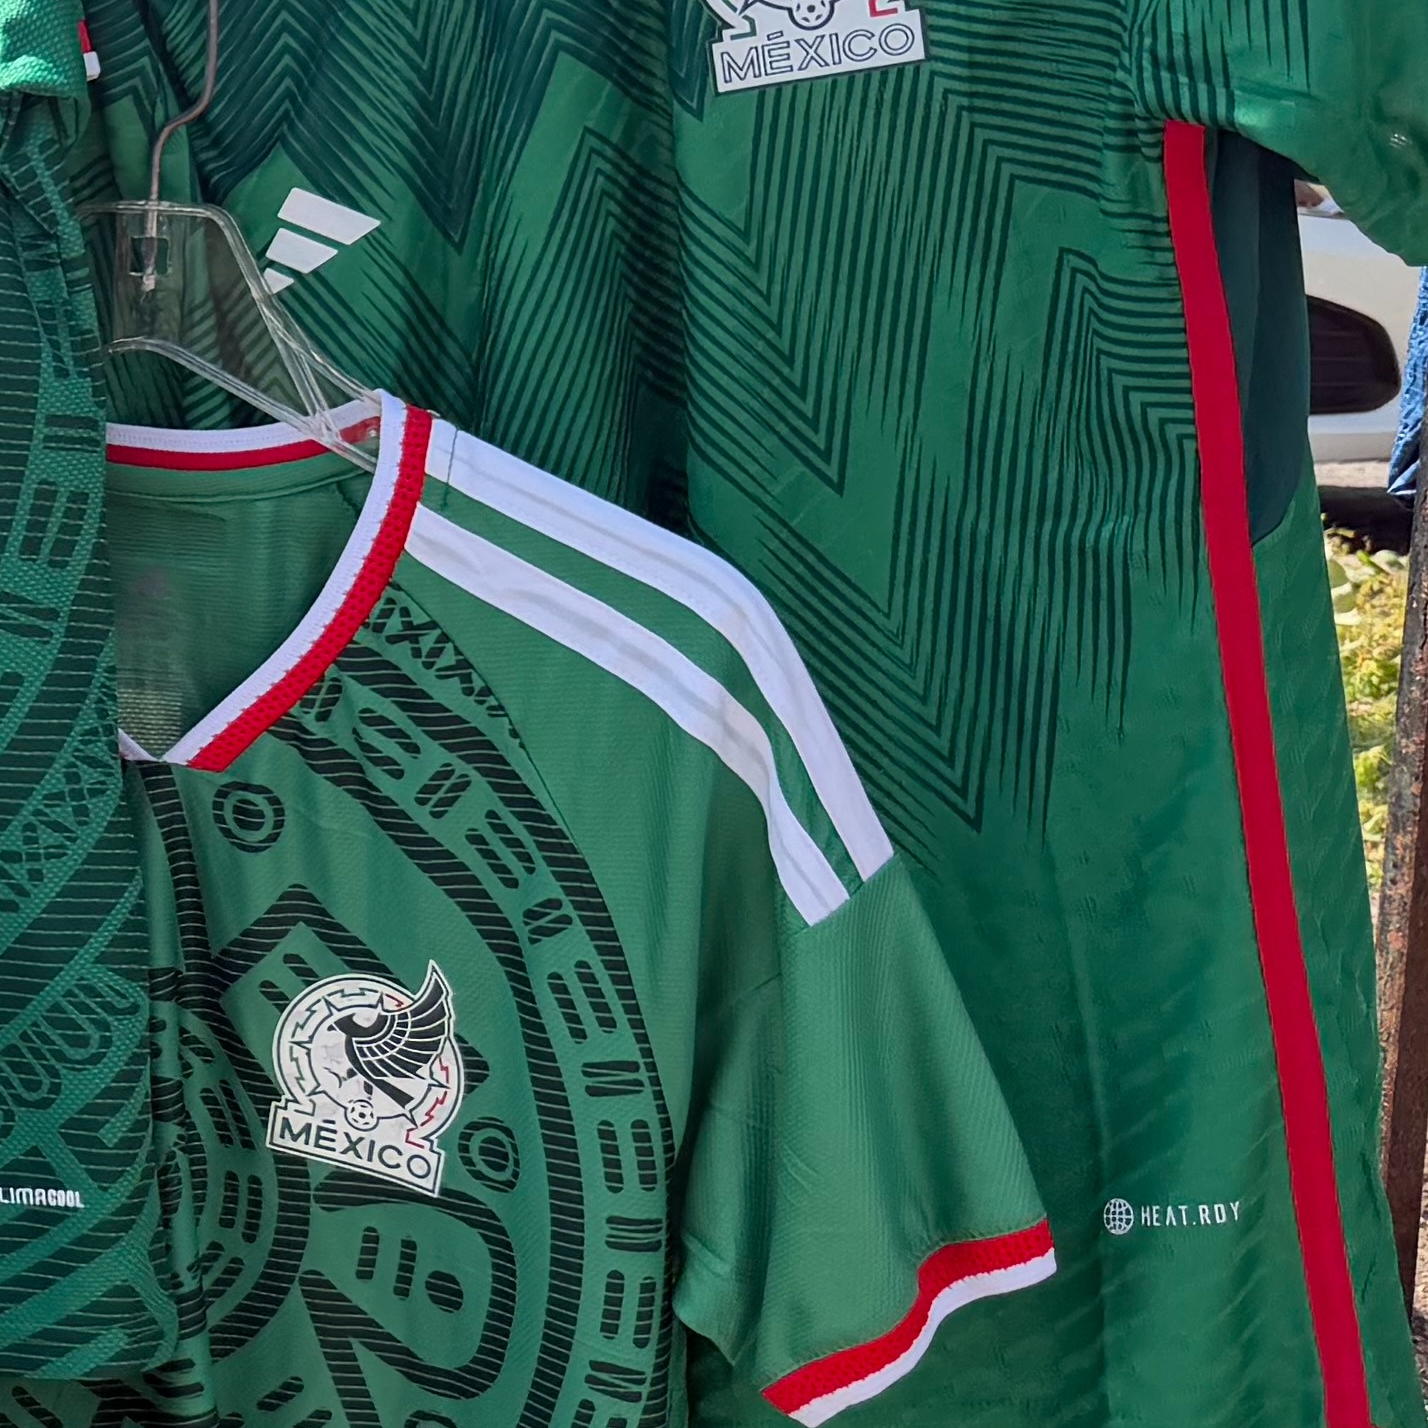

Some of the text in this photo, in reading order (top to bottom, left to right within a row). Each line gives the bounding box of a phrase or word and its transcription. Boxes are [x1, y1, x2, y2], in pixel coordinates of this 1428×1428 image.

[720, 22, 915, 84] MÉXICO
[278, 1116, 432, 1180] MÉXICO
[1140, 1200, 1240, 1228] HEAT.RDY
